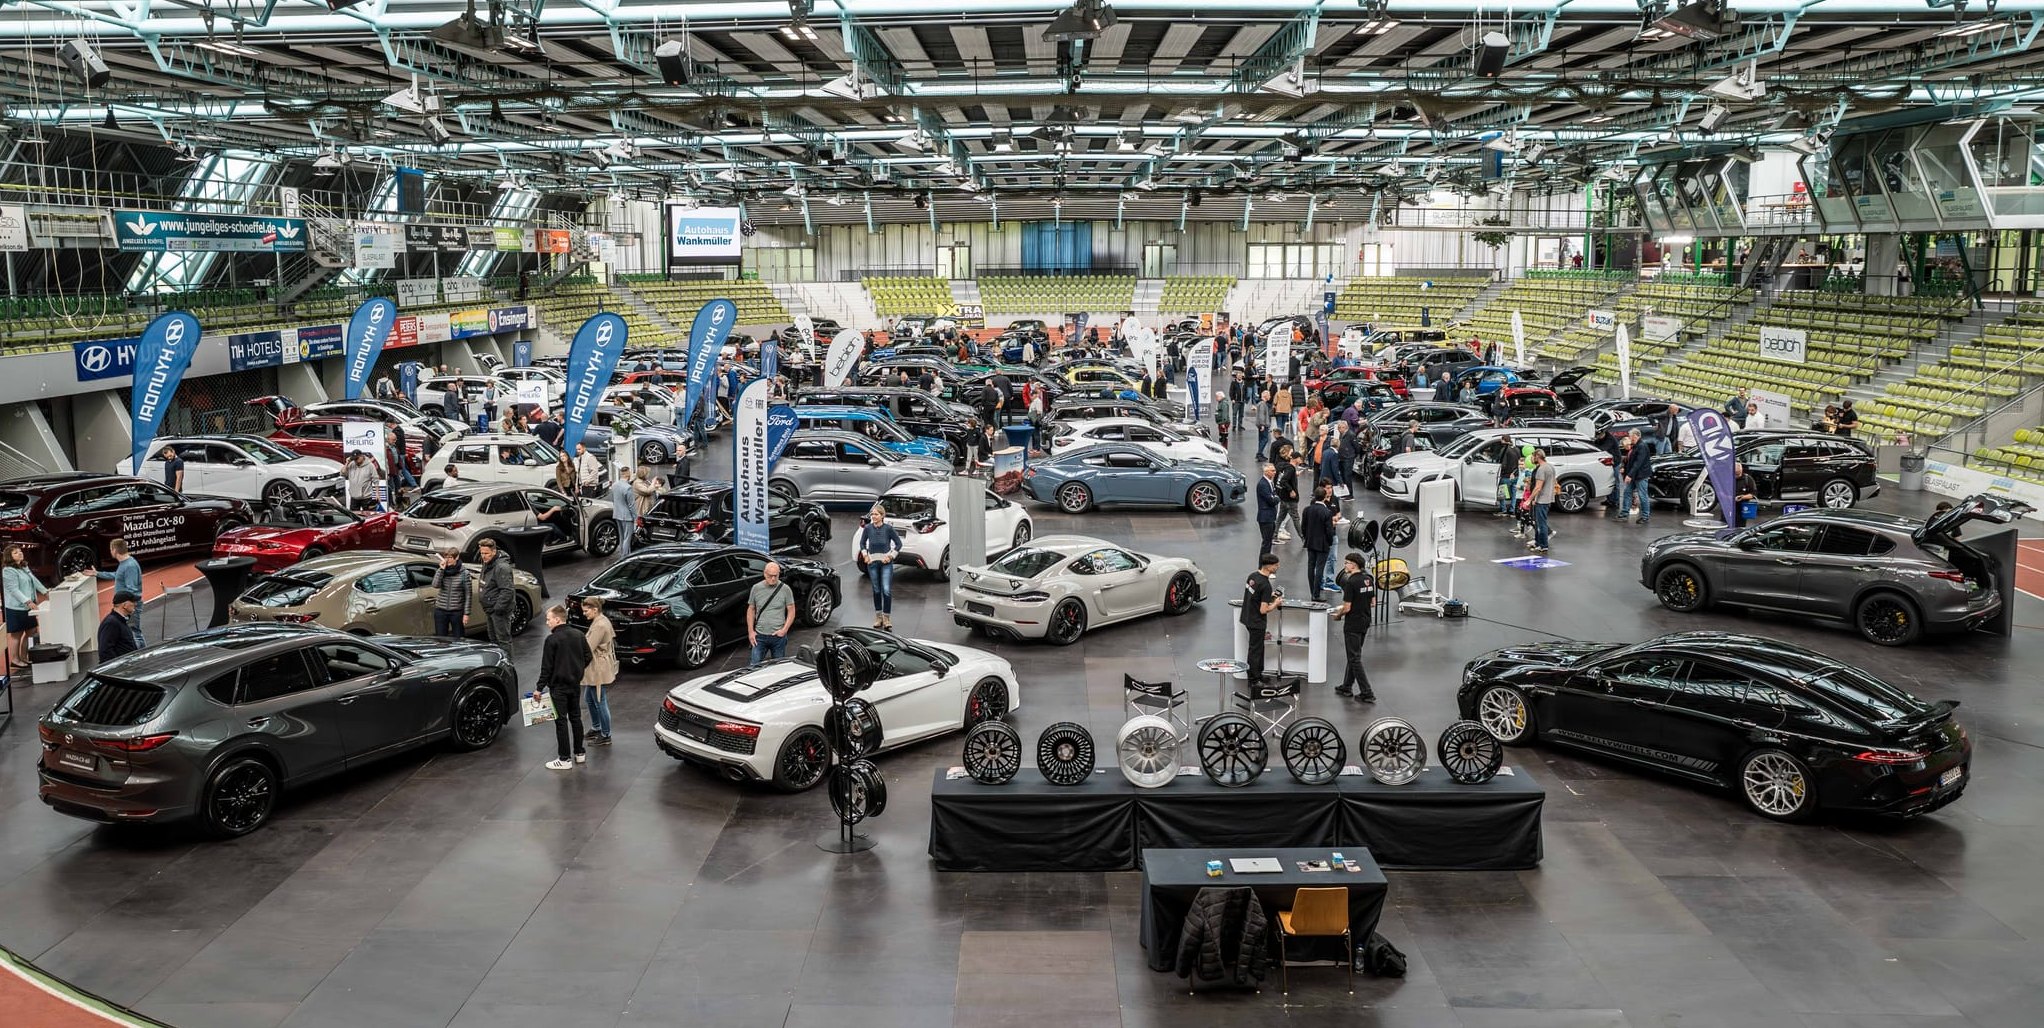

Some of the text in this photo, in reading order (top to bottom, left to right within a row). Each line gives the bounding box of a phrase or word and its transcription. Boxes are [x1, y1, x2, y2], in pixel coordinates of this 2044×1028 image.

[160, 218, 276, 234] www.jungeilges-schoeffel.de
[684, 225, 729, 235] Autohaus
[677, 236, 732, 246] Wankmüller
[941, 304, 982, 317] XTRA
[498, 311, 527, 327] Ensinger
[1595, 315, 1613, 325] SUZUKI
[247, 340, 281, 357] HOTELS
[767, 414, 795, 426] Ford
[346, 438, 374, 446] MEILING
[753, 417, 765, 525] Wankmüller
[740, 436, 750, 524] Autohaus
[123, 515, 185, 532] Mazda CX-80
[141, 535, 176, 546] Anhängelast
